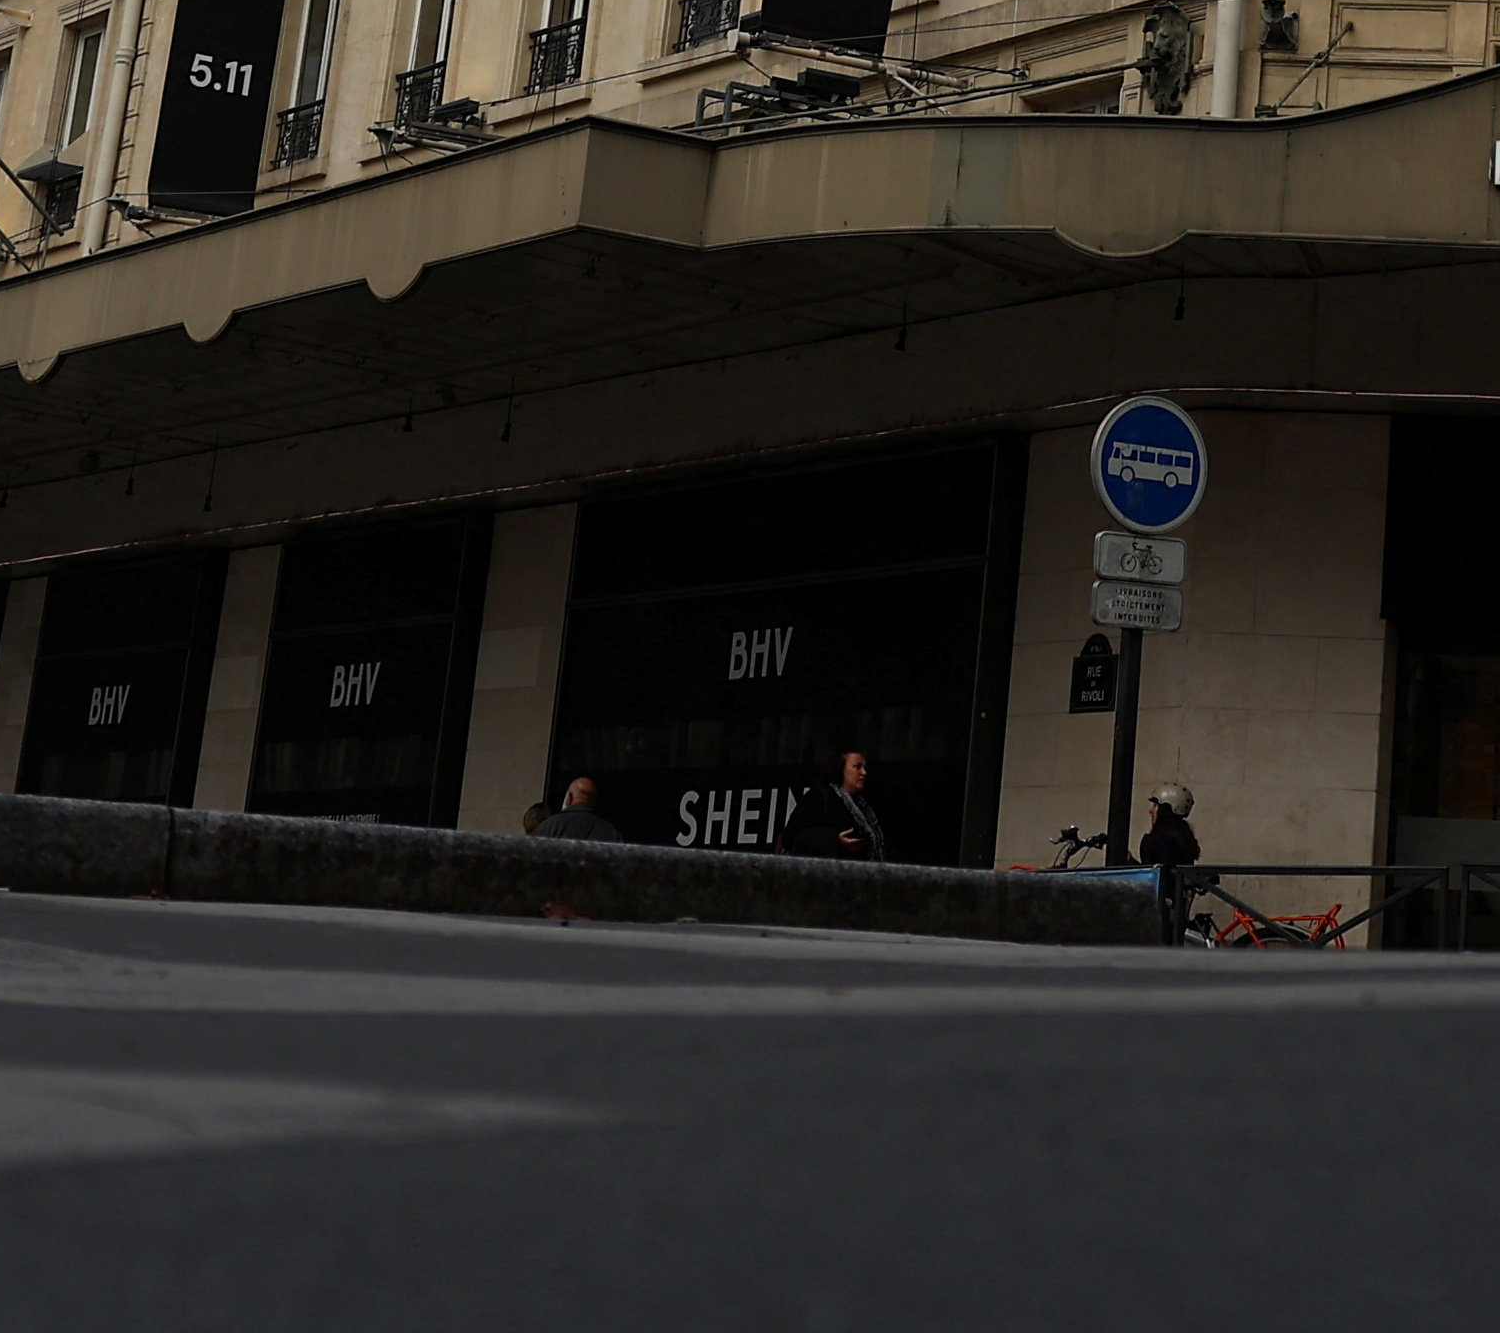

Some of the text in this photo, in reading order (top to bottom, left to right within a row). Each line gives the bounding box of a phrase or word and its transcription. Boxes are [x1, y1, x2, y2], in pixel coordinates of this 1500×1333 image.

[189, 53, 253, 97] 5.11
[727, 626, 795, 681] BHV
[1086, 665, 1103, 678] RUE
[87, 684, 131, 726] BHV
[329, 661, 381, 708] BHV
[1080, 689, 1105, 702] RIVOLI
